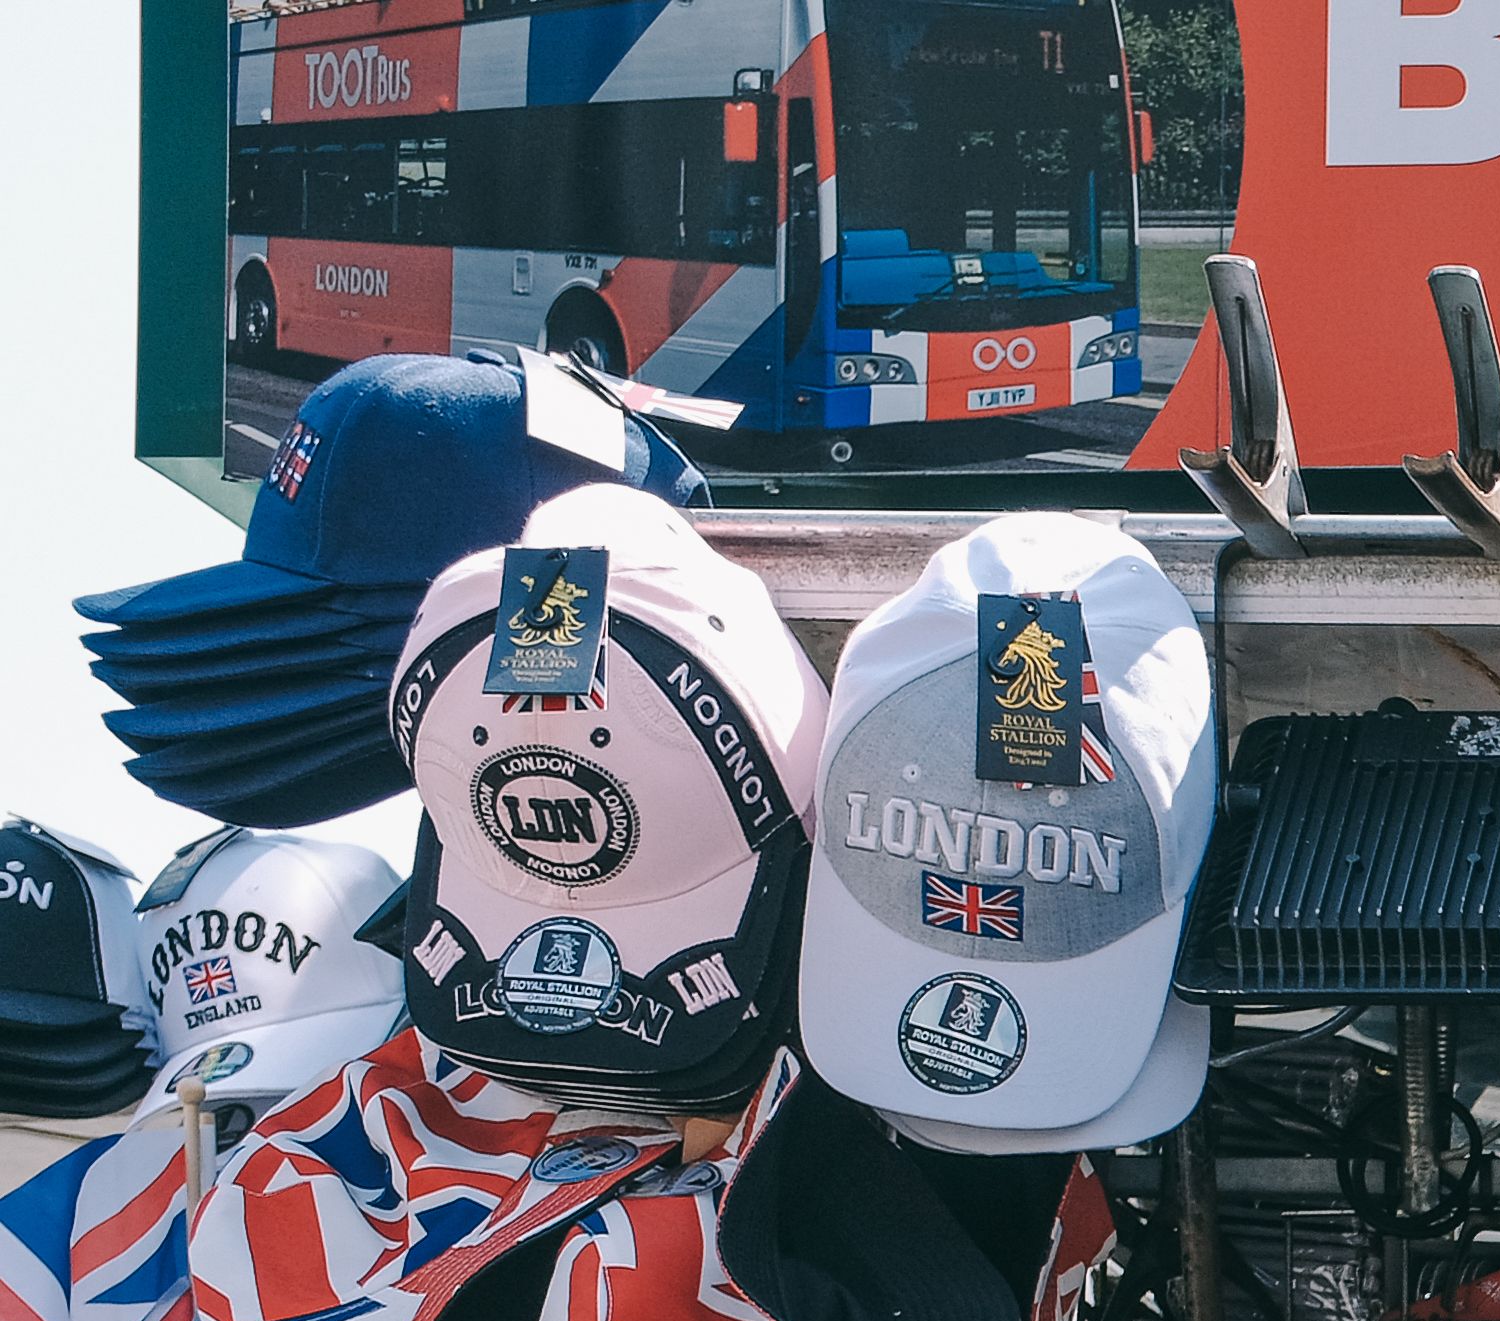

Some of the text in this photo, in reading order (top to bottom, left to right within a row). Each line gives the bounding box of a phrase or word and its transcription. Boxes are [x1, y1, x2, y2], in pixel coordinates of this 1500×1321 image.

[315, 263, 388, 297] LONDON
[990, 728, 1067, 747] STALLION
[1003, 713, 1052, 727] ROYAL
[666, 661, 774, 829] LONDON
[500, 755, 577, 778] LONDON
[500, 794, 597, 844] LDN
[845, 791, 1127, 896] LONDON
[148, 908, 331, 1017] LONDON
[509, 979, 603, 998] ROYAL STALLION
[666, 952, 742, 1015] LDN
[194, 994, 272, 1030] ENGLAND
[913, 1029, 1005, 1068] ROYAL STALLION
